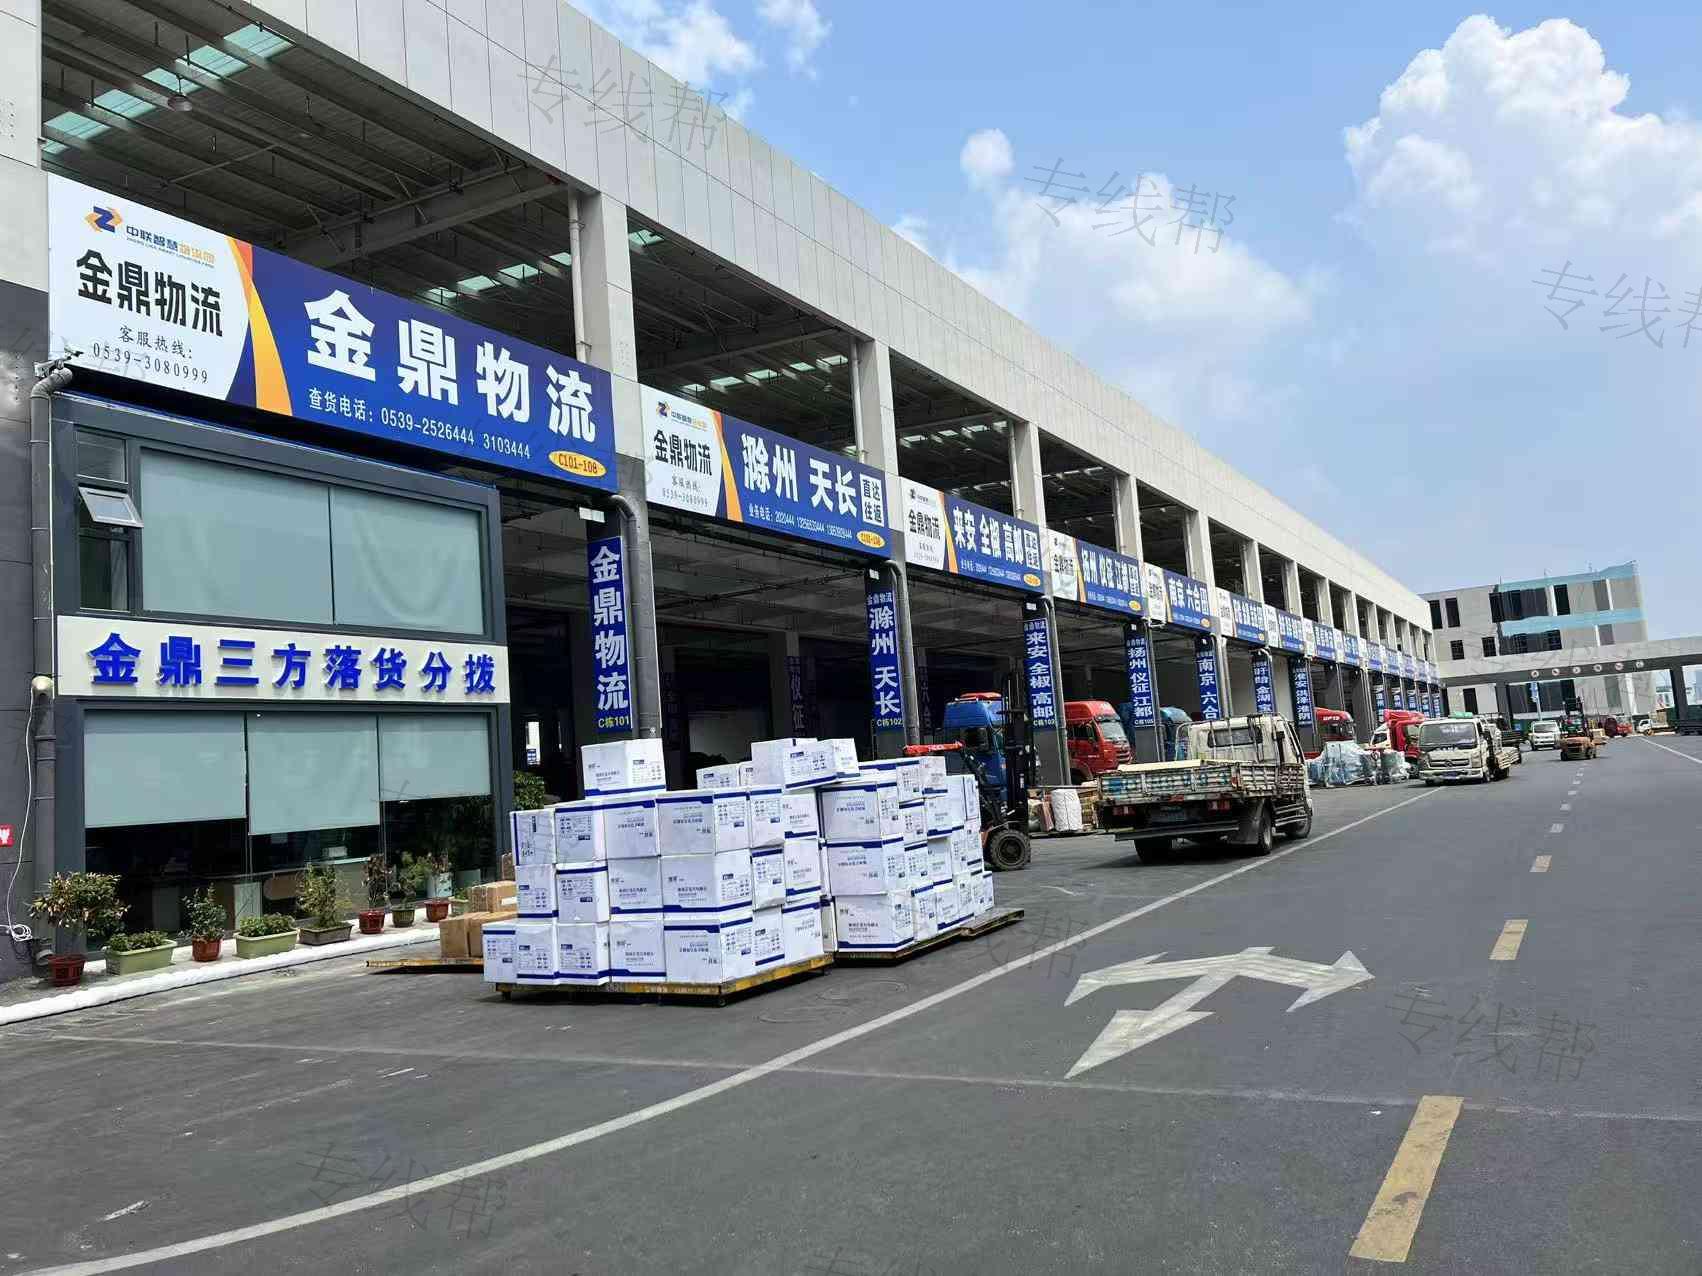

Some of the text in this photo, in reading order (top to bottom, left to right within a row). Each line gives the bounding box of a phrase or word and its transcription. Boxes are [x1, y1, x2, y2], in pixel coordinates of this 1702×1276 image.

[76, 248, 223, 337] 金鼎物流
[93, 341, 209, 384] 0539-3080999
[304, 289, 597, 444] 金鼎物流
[381, 406, 475, 446] 0539-2526444
[483, 432, 531, 459] 3103444
[654, 429, 713, 477] 金鼎物流
[558, 452, 599, 475] C101-108
[741, 432, 857, 518] 滁州 天长
[590, 545, 628, 711] 金鼎物流
[90, 631, 497, 695] 金鼎三方落货分拨
[869, 605, 901, 716] 滁州 天长
[1127, 646, 1147, 670] 扬州
[1199, 658, 1216, 686] 南京
[1130, 672, 1150, 694] 仪征
[1133, 696, 1153, 718] 江都
[1201, 691, 1219, 720] 六合
